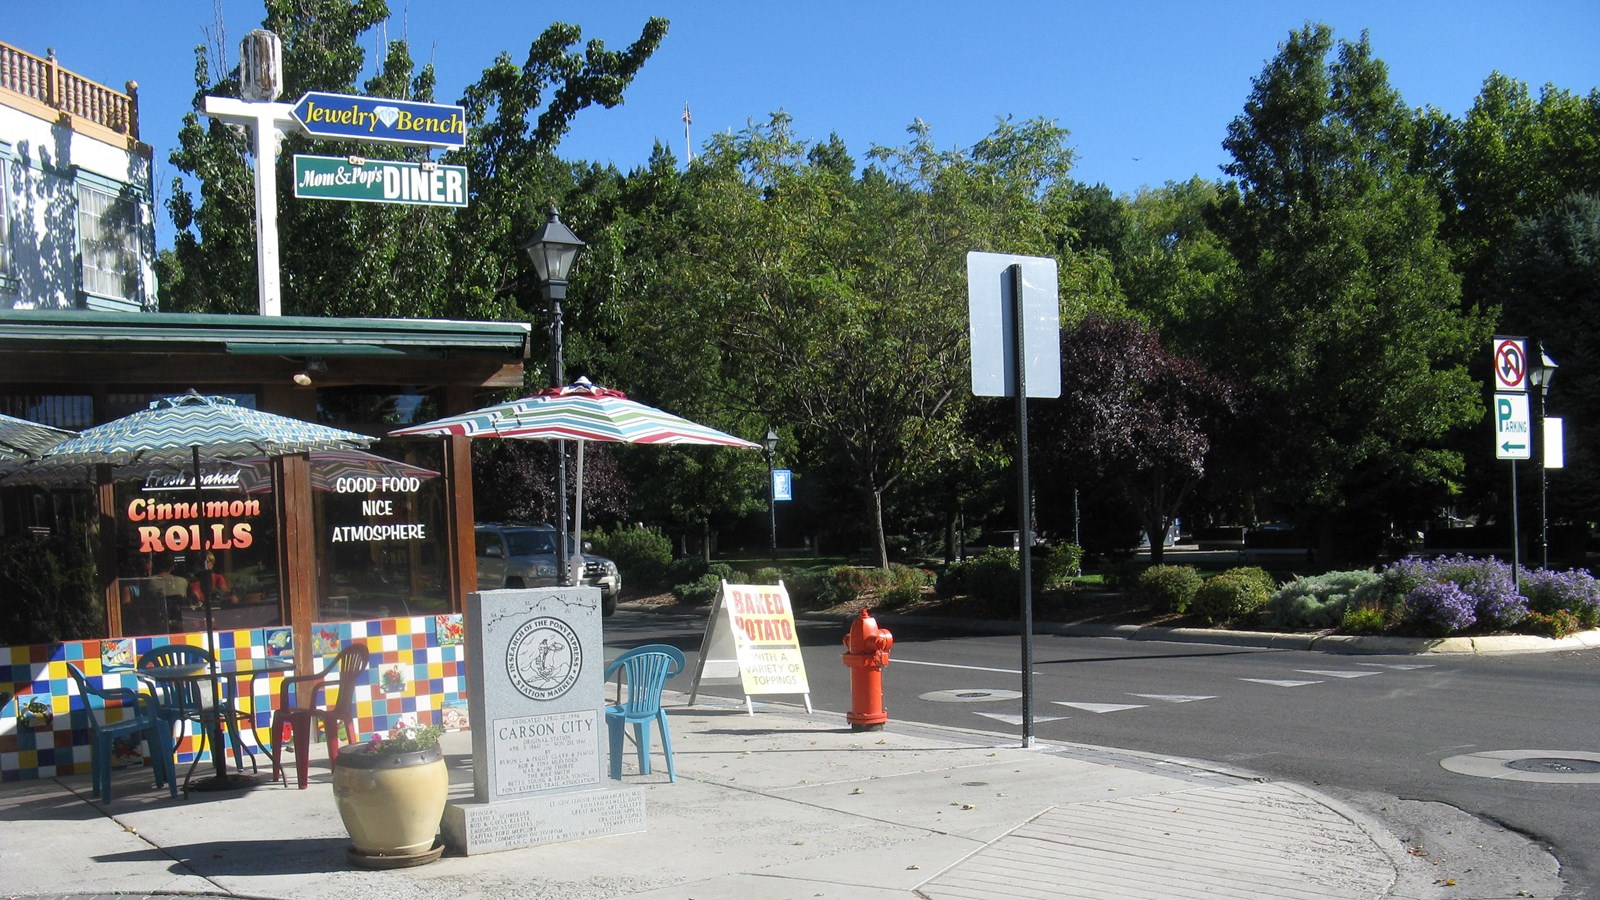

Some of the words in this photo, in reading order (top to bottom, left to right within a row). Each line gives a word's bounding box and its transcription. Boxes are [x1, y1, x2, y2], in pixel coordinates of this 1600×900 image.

[305, 102, 380, 132] Jewelry
[396, 111, 463, 134] Bench
[384, 166, 463, 203] DINER
[145, 469, 186, 487] Fresh
[336, 478, 376, 494] GOOD
[382, 477, 420, 492] FOOD
[128, 498, 260, 522] Cinnamon
[362, 500, 392, 516] NICE
[138, 522, 253, 552] ROLLS
[332, 524, 426, 542] ATMOSPHERE
[732, 590, 784, 614] BAKED
[734, 616, 792, 641] POTATO
[509, 629, 524, 662] SEARCH
[523, 622, 532, 632] OF
[549, 620, 569, 634] PONY
[566, 631, 580, 667] EXPRESS
[746, 664, 784, 674] VARIETY
[788, 664, 800, 672] OF
[515, 678, 546, 699] STATION
[547, 674, 576, 698] MARKER
[752, 676, 798, 686] TOPPINGS
[499, 723, 554, 740] CARSON
[561, 719, 593, 734] CITY
[562, 777, 596, 786] ASSOCIATION
